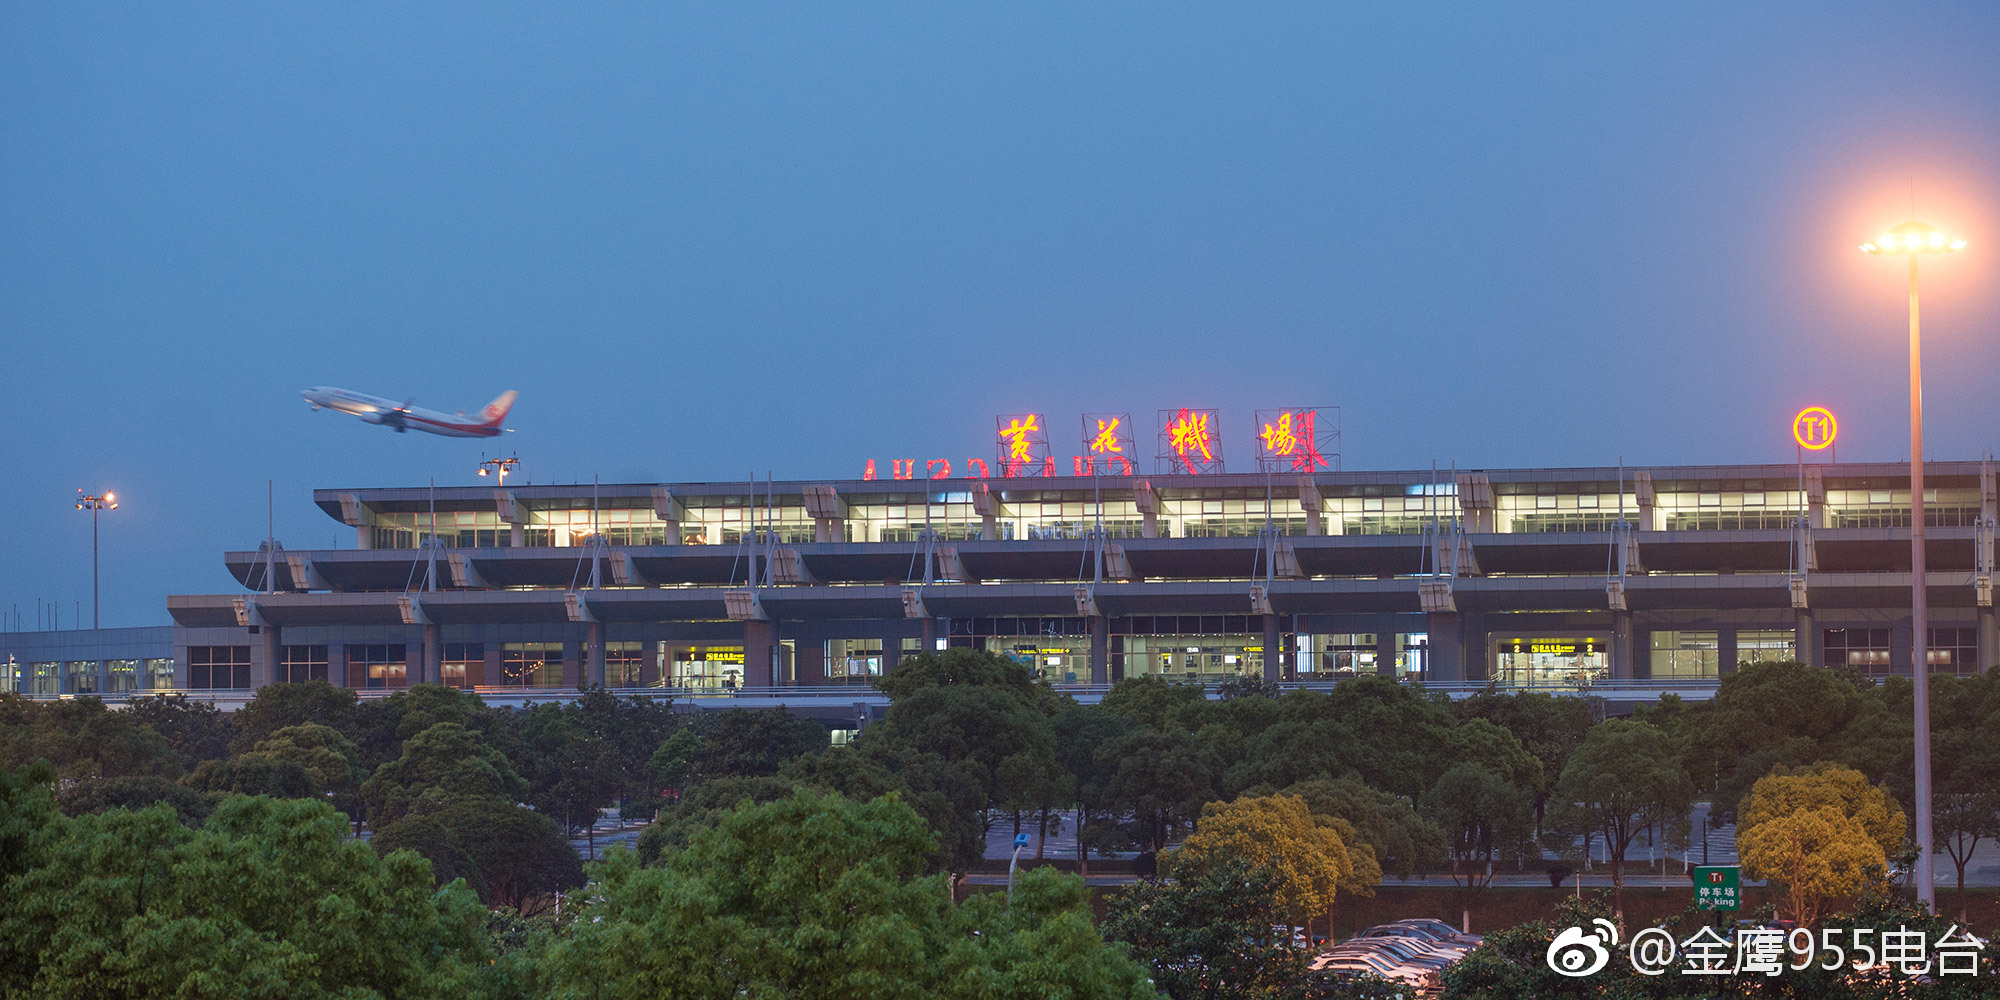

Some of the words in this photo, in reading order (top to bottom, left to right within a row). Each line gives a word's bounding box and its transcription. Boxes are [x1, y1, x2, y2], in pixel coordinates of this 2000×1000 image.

[1802, 417, 1828, 441] T1
[1711, 872, 1722, 881] T1
[1700, 887, 1734, 897] 停车场
[1700, 898, 1734, 907] Pking
